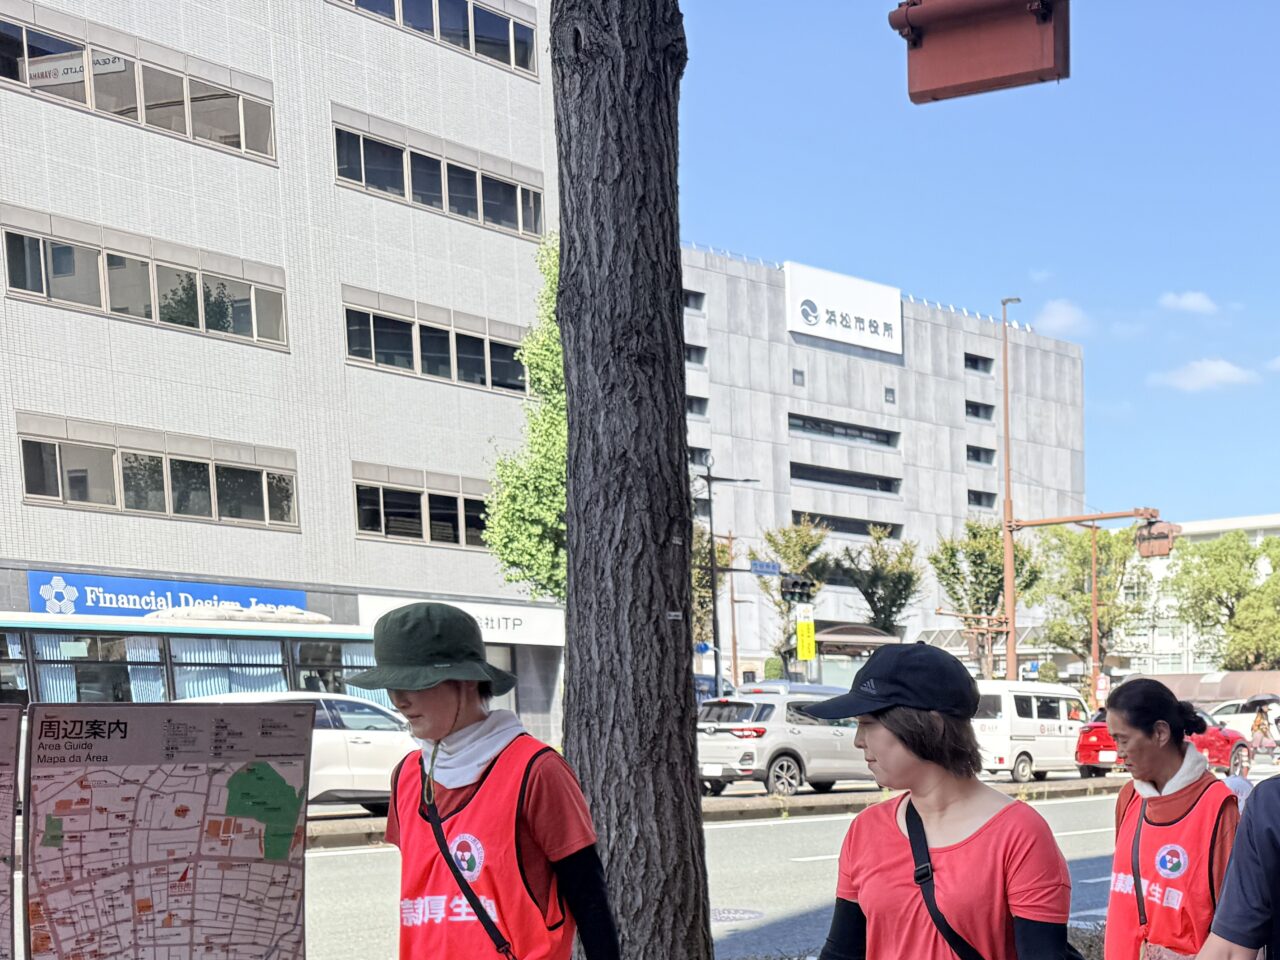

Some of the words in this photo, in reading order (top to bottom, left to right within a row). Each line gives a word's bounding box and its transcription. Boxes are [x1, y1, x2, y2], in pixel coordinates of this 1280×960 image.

[825, 308, 894, 339] 浜松市役所
[84, 586, 173, 610] Financial
[38, 719, 129, 740] 周辺案内
[38, 742, 61, 751] Area
[64, 741, 93, 751] Guide
[37, 754, 66, 765] Mapa
[69, 754, 82, 763] da
[85, 753, 108, 763] Área
